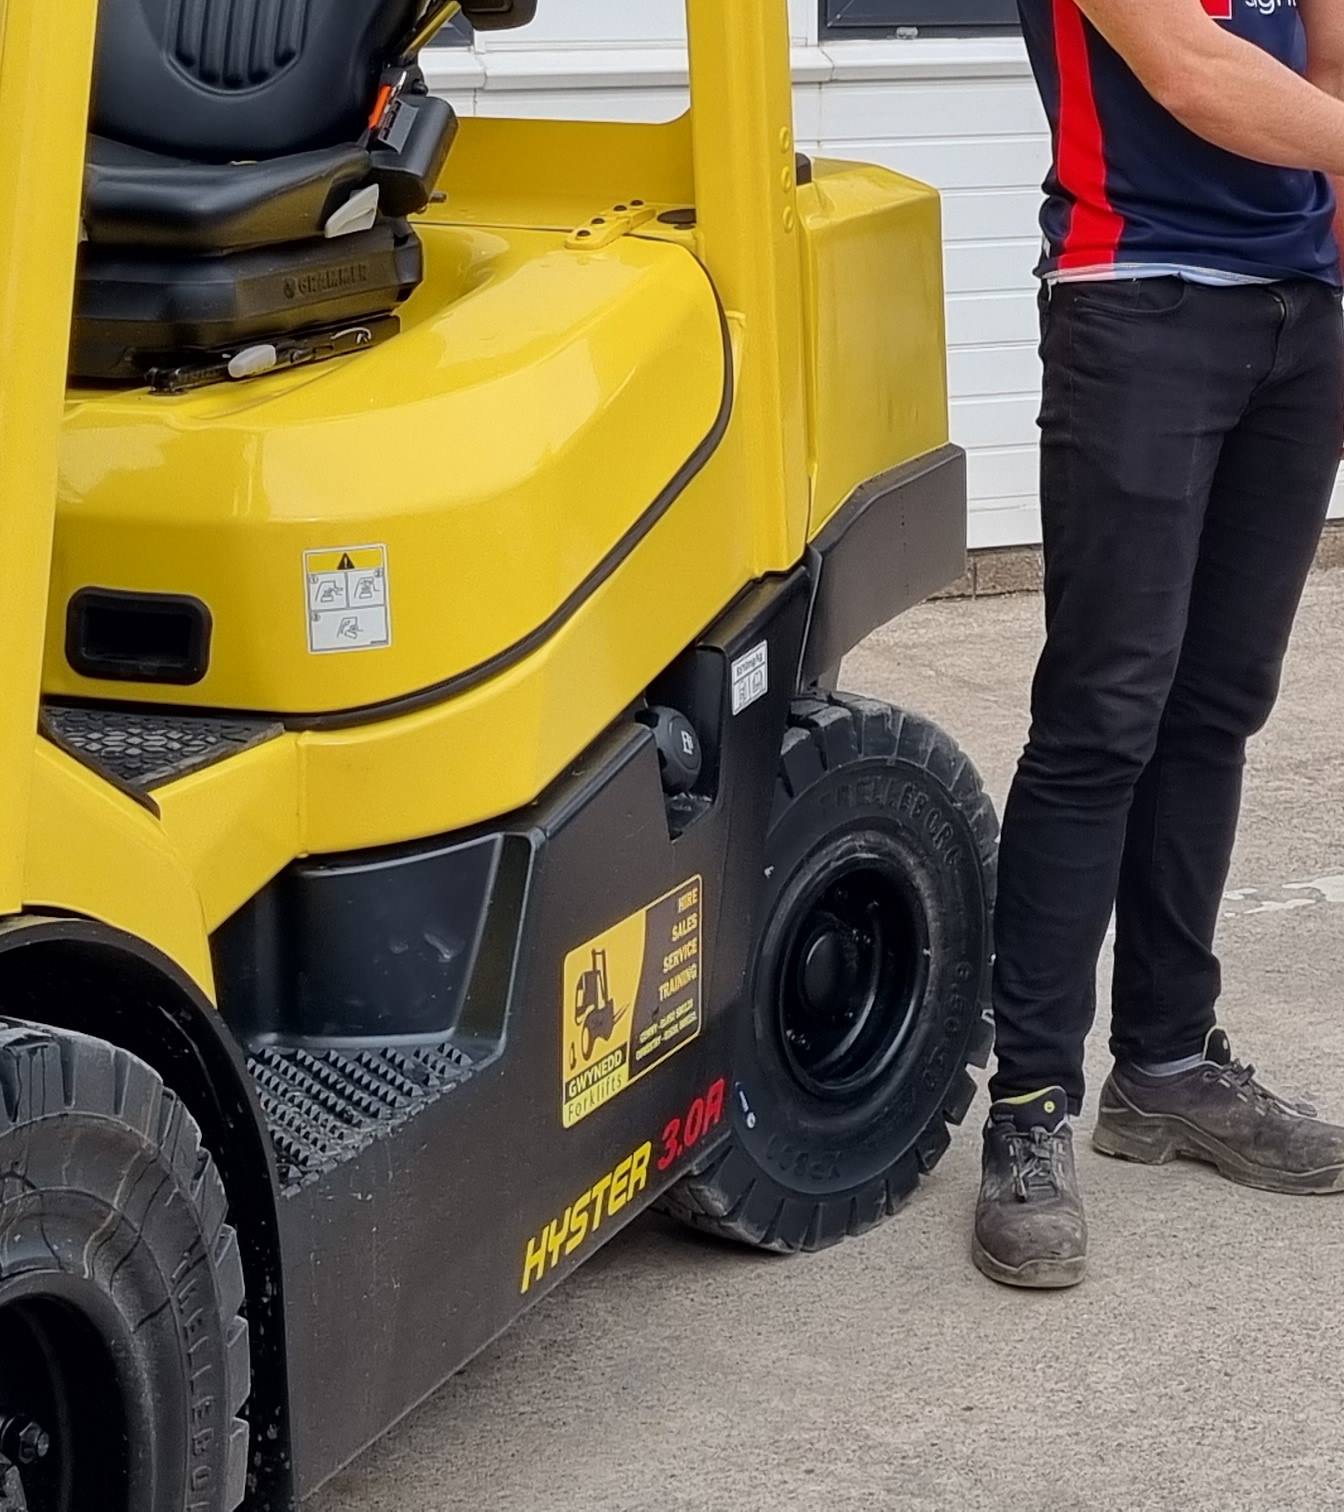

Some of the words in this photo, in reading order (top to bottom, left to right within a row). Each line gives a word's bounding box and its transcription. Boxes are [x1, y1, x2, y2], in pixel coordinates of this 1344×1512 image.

[677, 888, 698, 914] HIRE
[672, 913, 698, 942] SALES
[663, 937, 698, 973] SERVICE
[658, 963, 698, 1002] TRAINING
[568, 1049, 623, 1099] GWYNEDD
[568, 1073, 623, 1122] Forklifts
[520, 1140, 652, 1294] HYSTER
